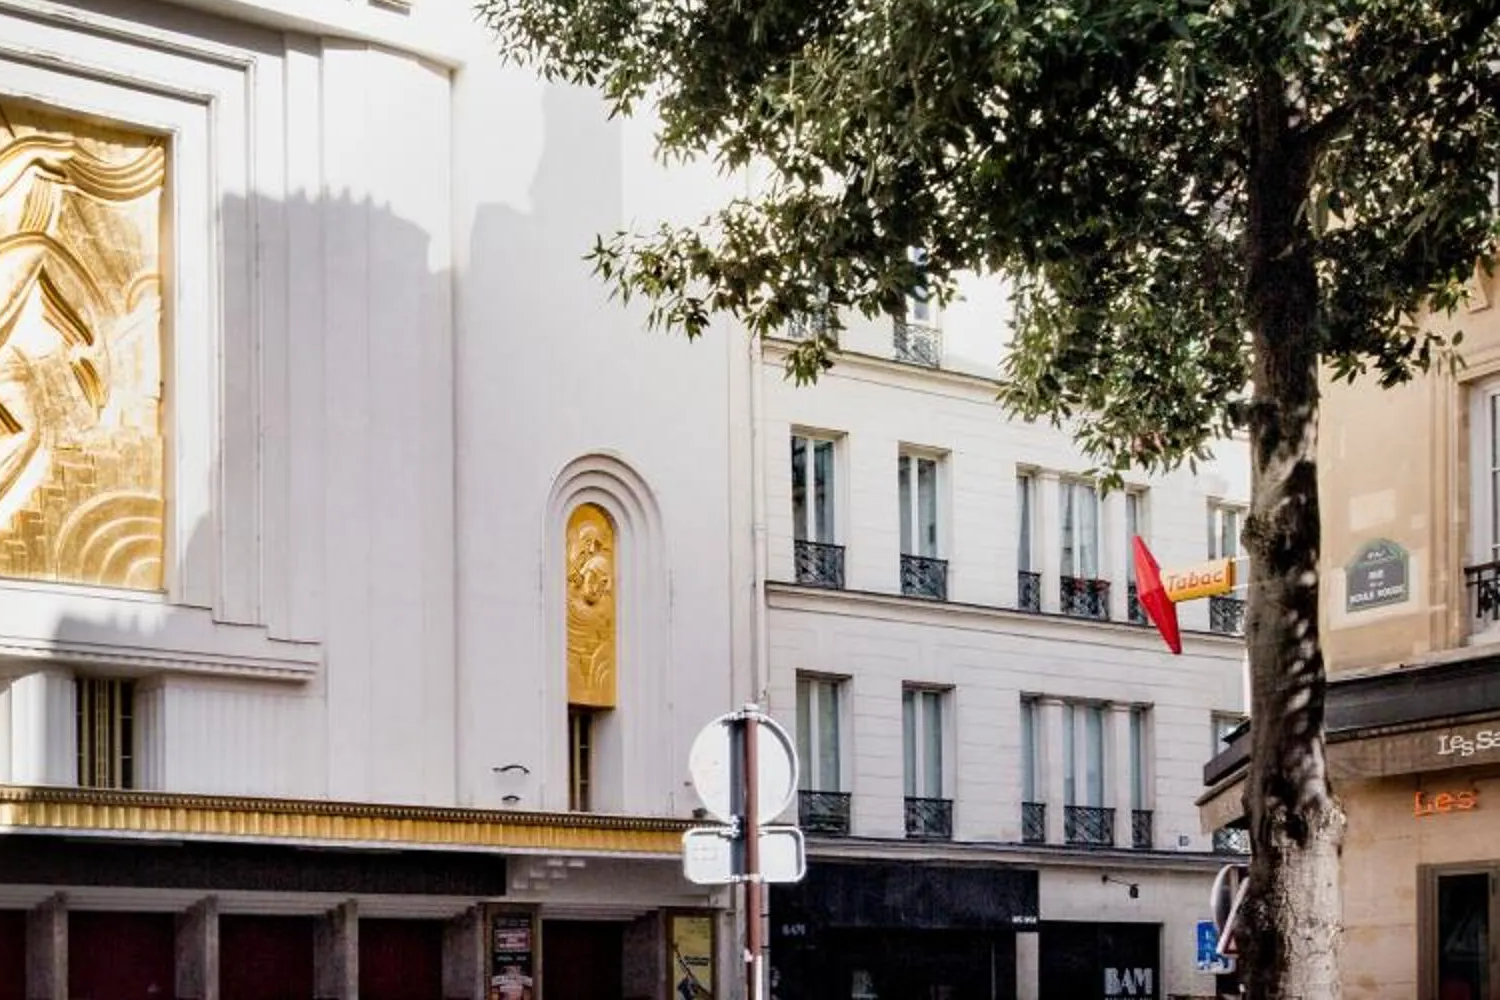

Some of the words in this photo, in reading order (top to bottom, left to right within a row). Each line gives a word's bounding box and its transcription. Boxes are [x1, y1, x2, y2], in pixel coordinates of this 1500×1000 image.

[1167, 570, 1222, 593] Tabac
[1437, 735, 1475, 757] Les
[1413, 791, 1478, 816] Les
[1104, 967, 1153, 995] BAM
